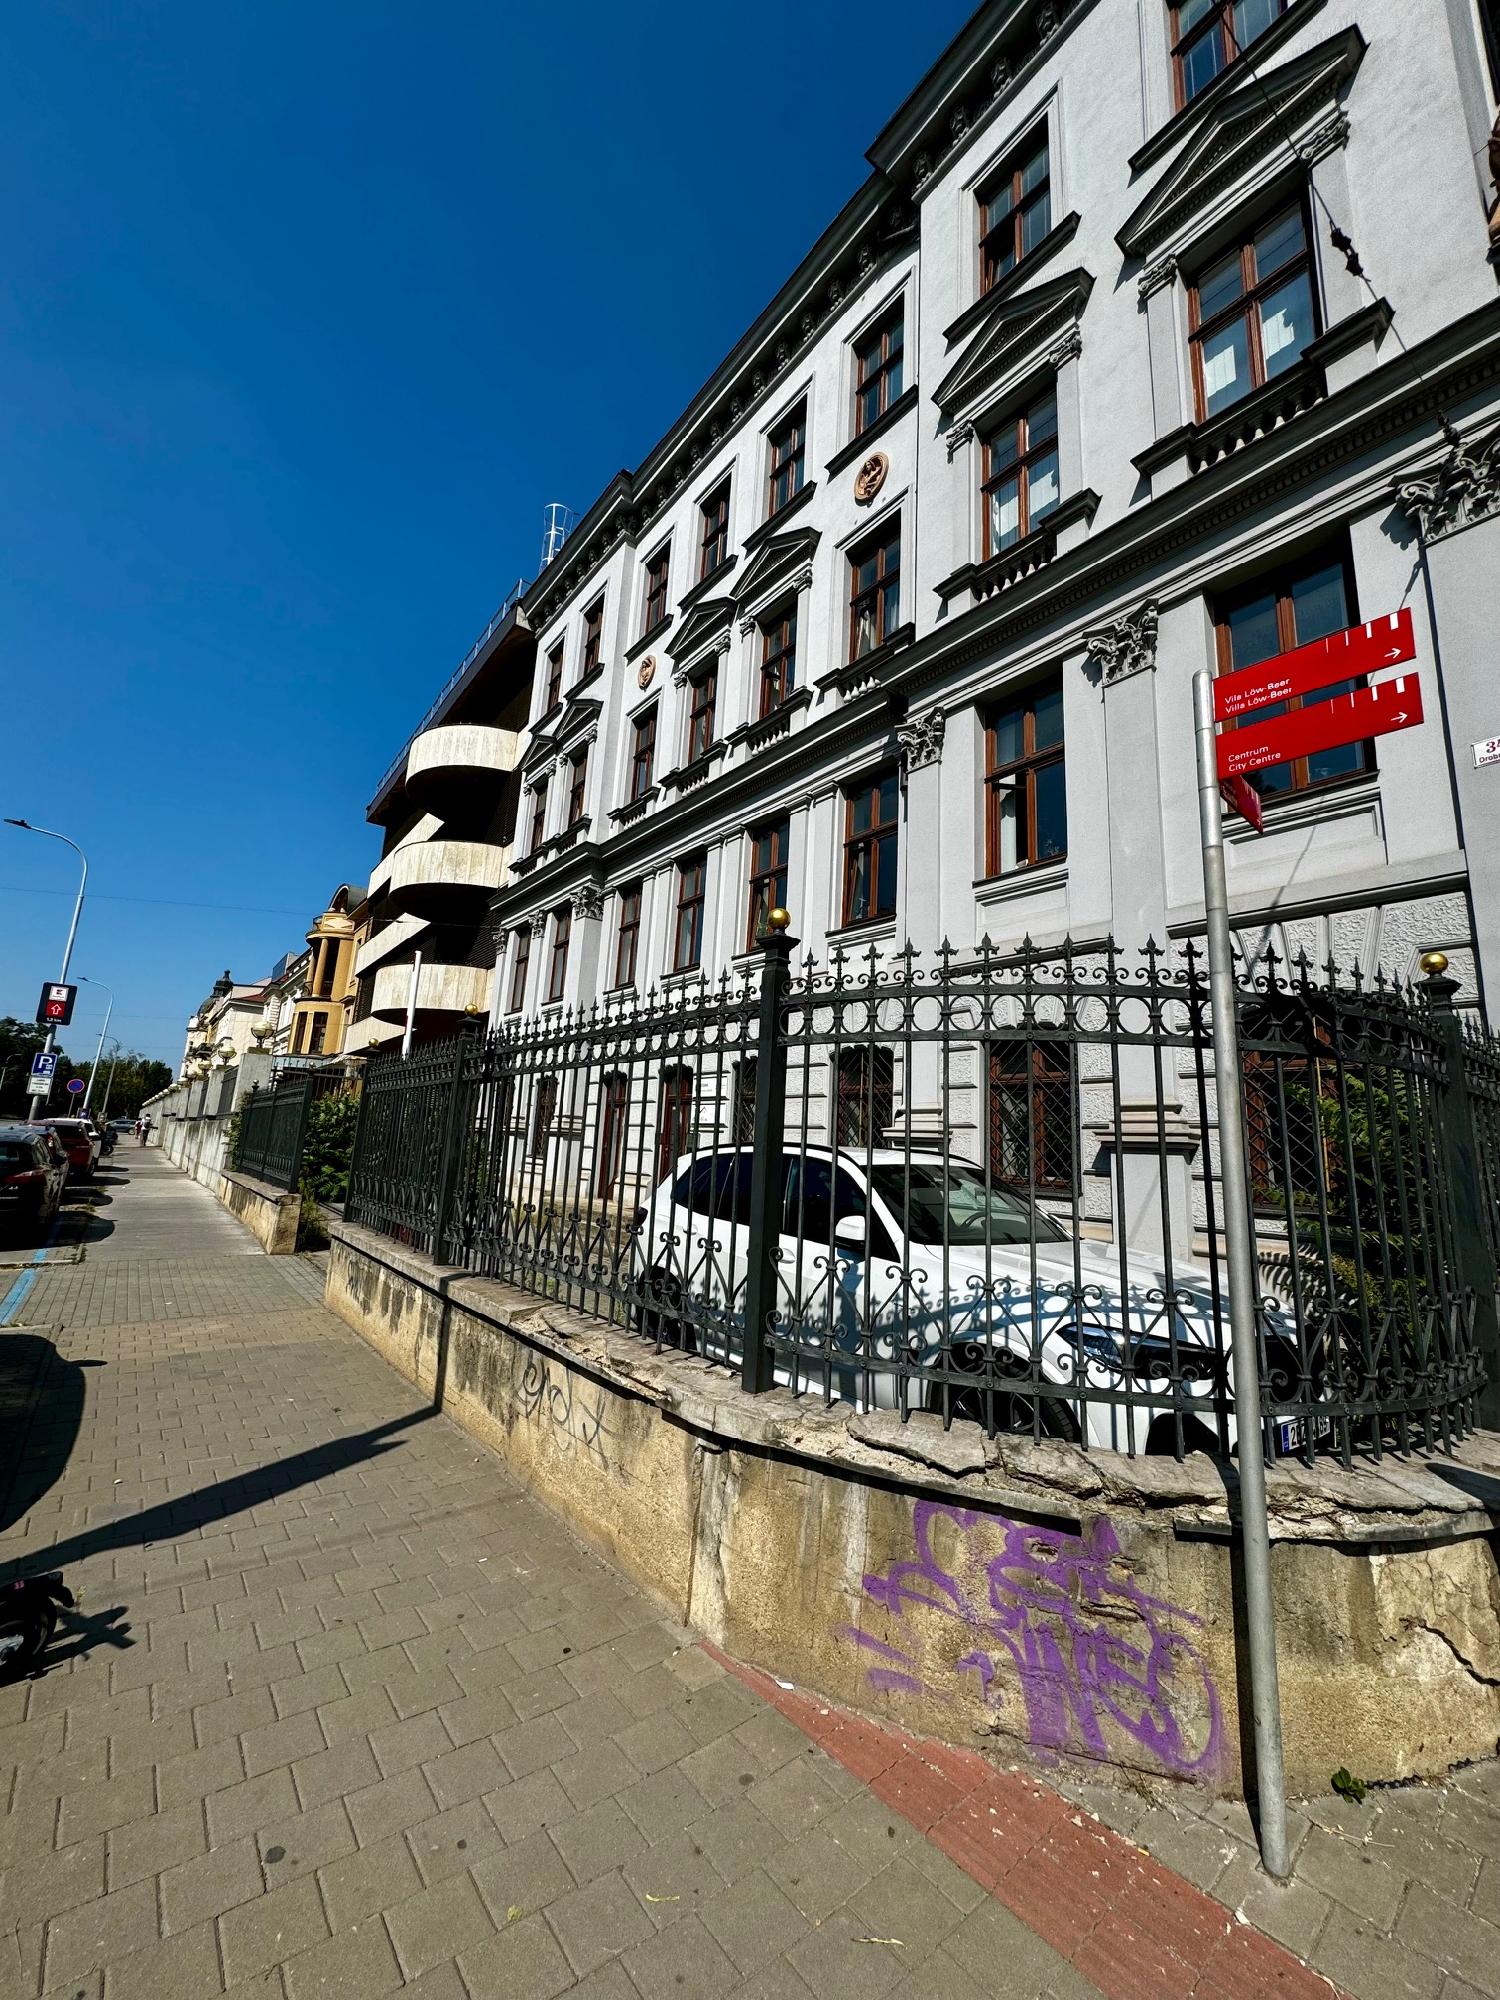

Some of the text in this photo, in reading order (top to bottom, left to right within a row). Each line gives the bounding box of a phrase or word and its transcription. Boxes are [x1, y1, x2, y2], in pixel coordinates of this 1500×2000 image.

[1225, 678, 1291, 704] Vila Löw-Beer
[1225, 687, 1293, 714] Villa Löw-Beer
[1228, 746, 1269, 762] Centrum
[1228, 752, 1281, 772] City Centre
[38, 1056, 52, 1068] P
